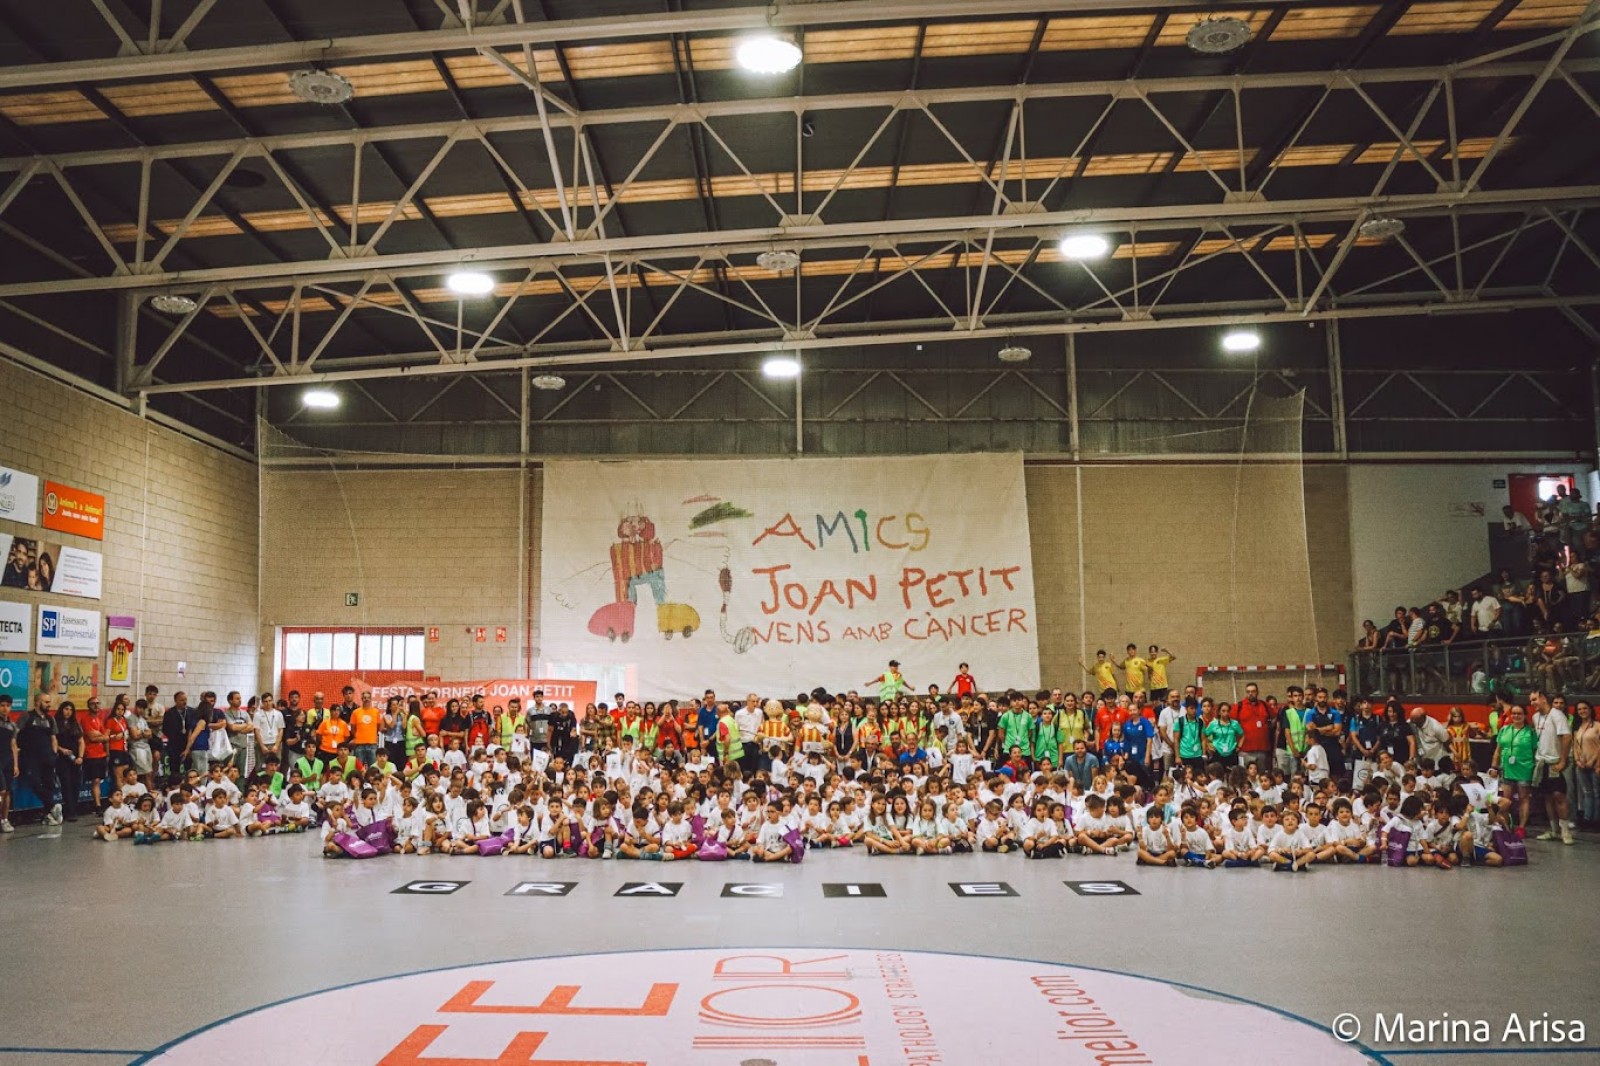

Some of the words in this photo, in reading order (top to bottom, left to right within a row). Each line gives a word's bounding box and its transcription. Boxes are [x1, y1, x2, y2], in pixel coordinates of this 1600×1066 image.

[752, 564, 876, 615] JOAN
[899, 566, 1021, 609] PETIT
[42, 617, 56, 632] SP
[751, 620, 830, 645] NENS
[842, 622, 893, 641] AMB
[491, 684, 529, 697] JOAN
